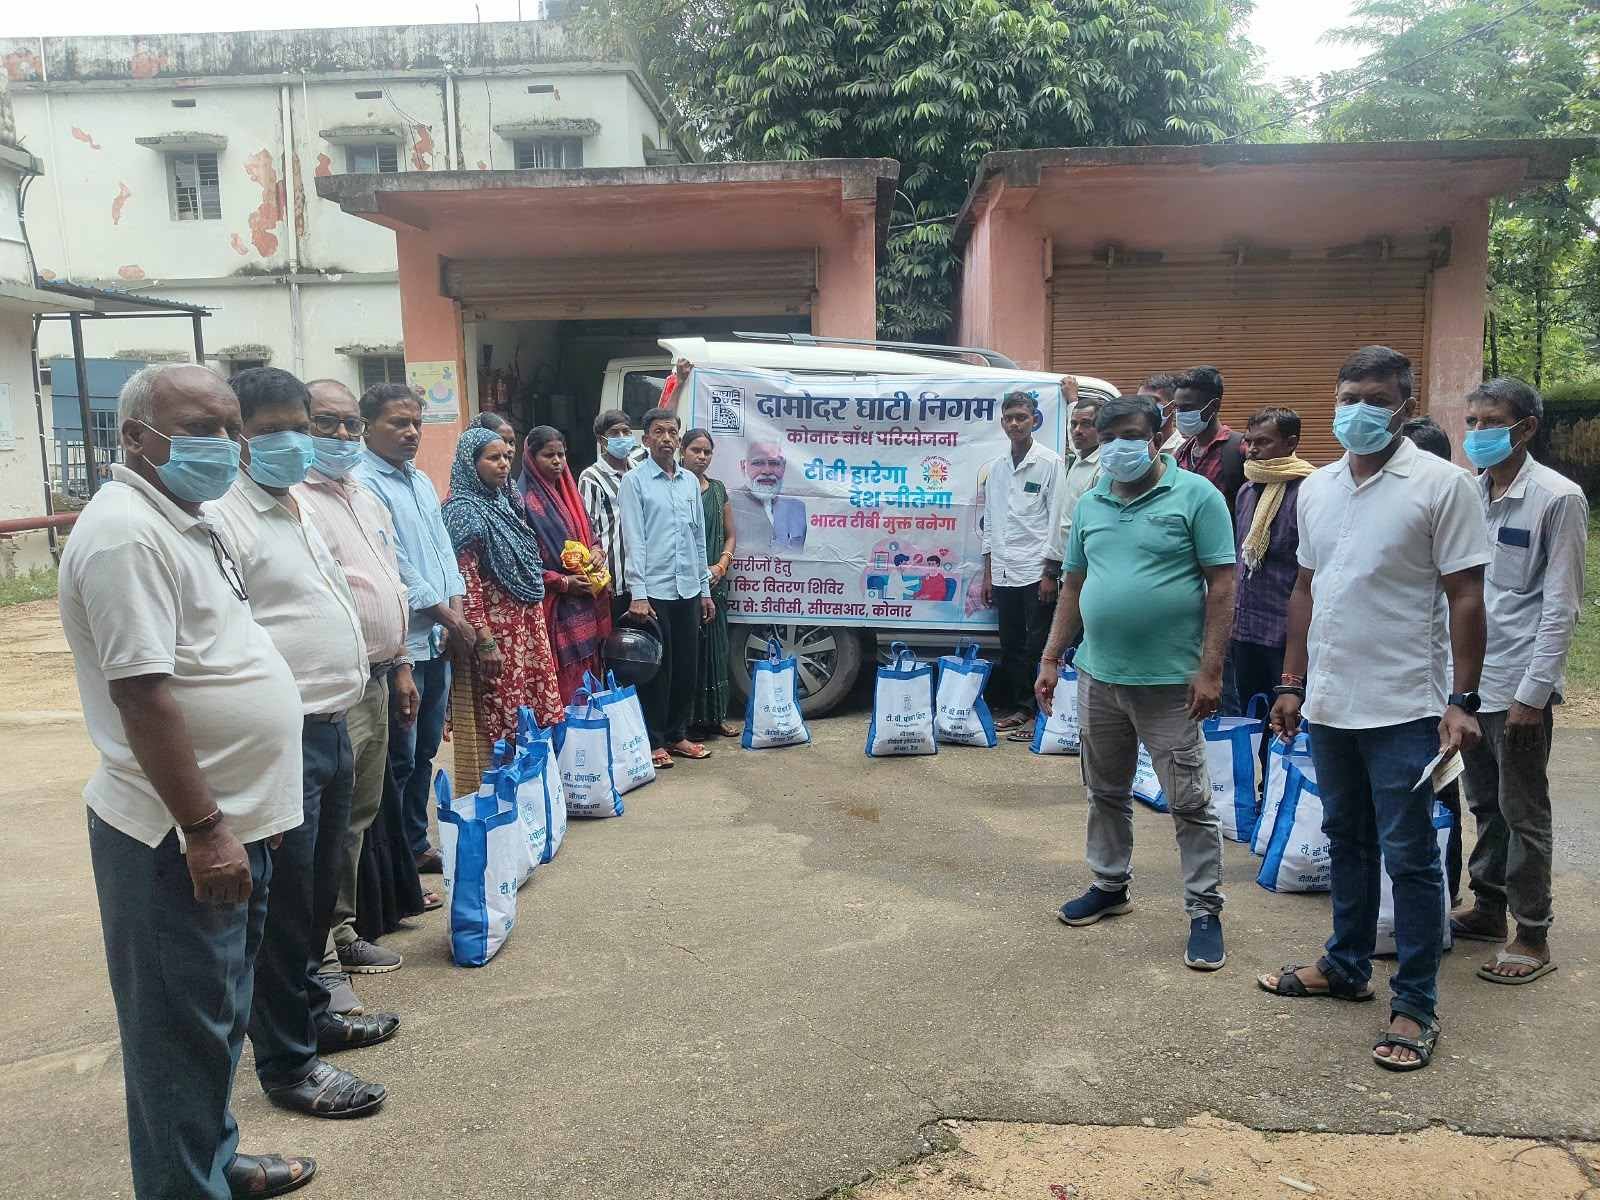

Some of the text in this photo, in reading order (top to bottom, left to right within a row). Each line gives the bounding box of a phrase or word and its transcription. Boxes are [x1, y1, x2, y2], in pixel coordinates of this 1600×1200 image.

[756, 390, 848, 421] दामोदर
[856, 391, 911, 422] घाटी
[919, 391, 998, 421] निगम
[786, 425, 959, 447] कोनार बाँध परियोजना
[804, 457, 846, 482] टीबी
[850, 461, 906, 484] हारेगा
[849, 484, 952, 509] देश जीतेगा
[810, 511, 956, 534] भारत टीबी मुक्त बनेगा
[733, 555, 792, 577] मरीजों हेतु
[733, 576, 761, 593] किट
[763, 577, 805, 594] वितरण
[808, 578, 844, 596] शिविर
[872, 602, 912, 618] कोनार
